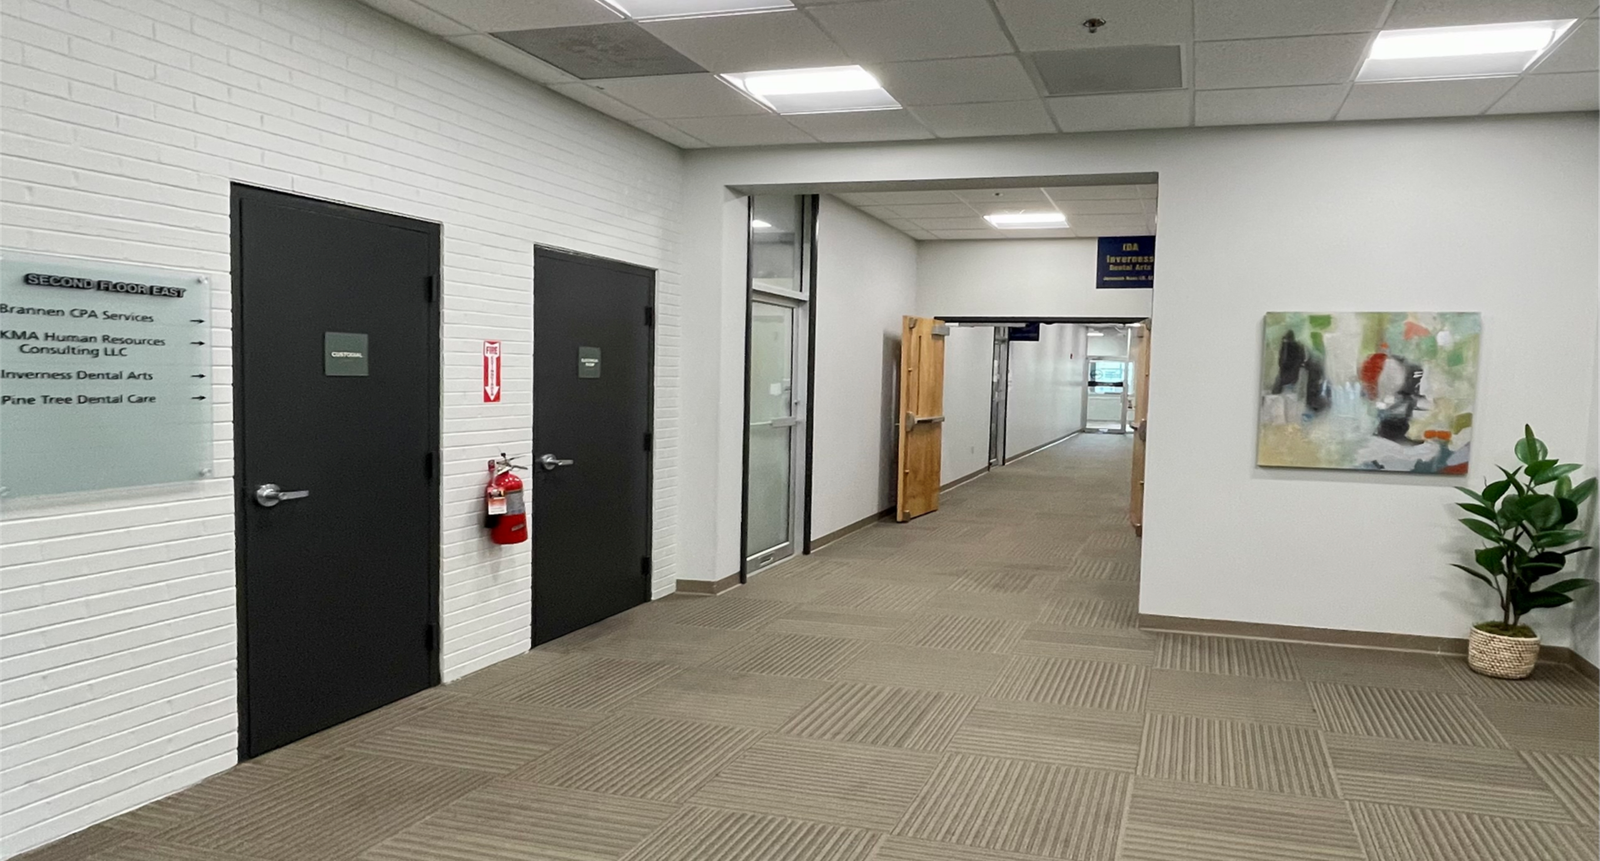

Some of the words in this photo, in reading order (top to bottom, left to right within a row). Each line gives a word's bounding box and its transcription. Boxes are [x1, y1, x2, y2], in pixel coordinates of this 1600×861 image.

[1106, 255, 1154, 263] Inverness
[24, 273, 95, 290] SECOND
[97, 280, 149, 295] FLOOR
[150, 285, 187, 298] EAST
[0, 303, 65, 317] Brannen
[69, 308, 99, 319] CPA
[102, 310, 154, 323] Services
[0, 330, 39, 341] KMA
[44, 332, 98, 343] Human
[102, 334, 166, 346] Resources
[19, 343, 100, 358] Consulting
[104, 346, 128, 357] LLC
[1, 369, 72, 380] Inverness
[76, 370, 123, 380] Dental
[127, 371, 154, 381] Arts
[1, 395, 36, 405] Pine
[41, 395, 73, 405] Tree
[77, 394, 123, 405] Dental
[127, 394, 157, 404] Care
